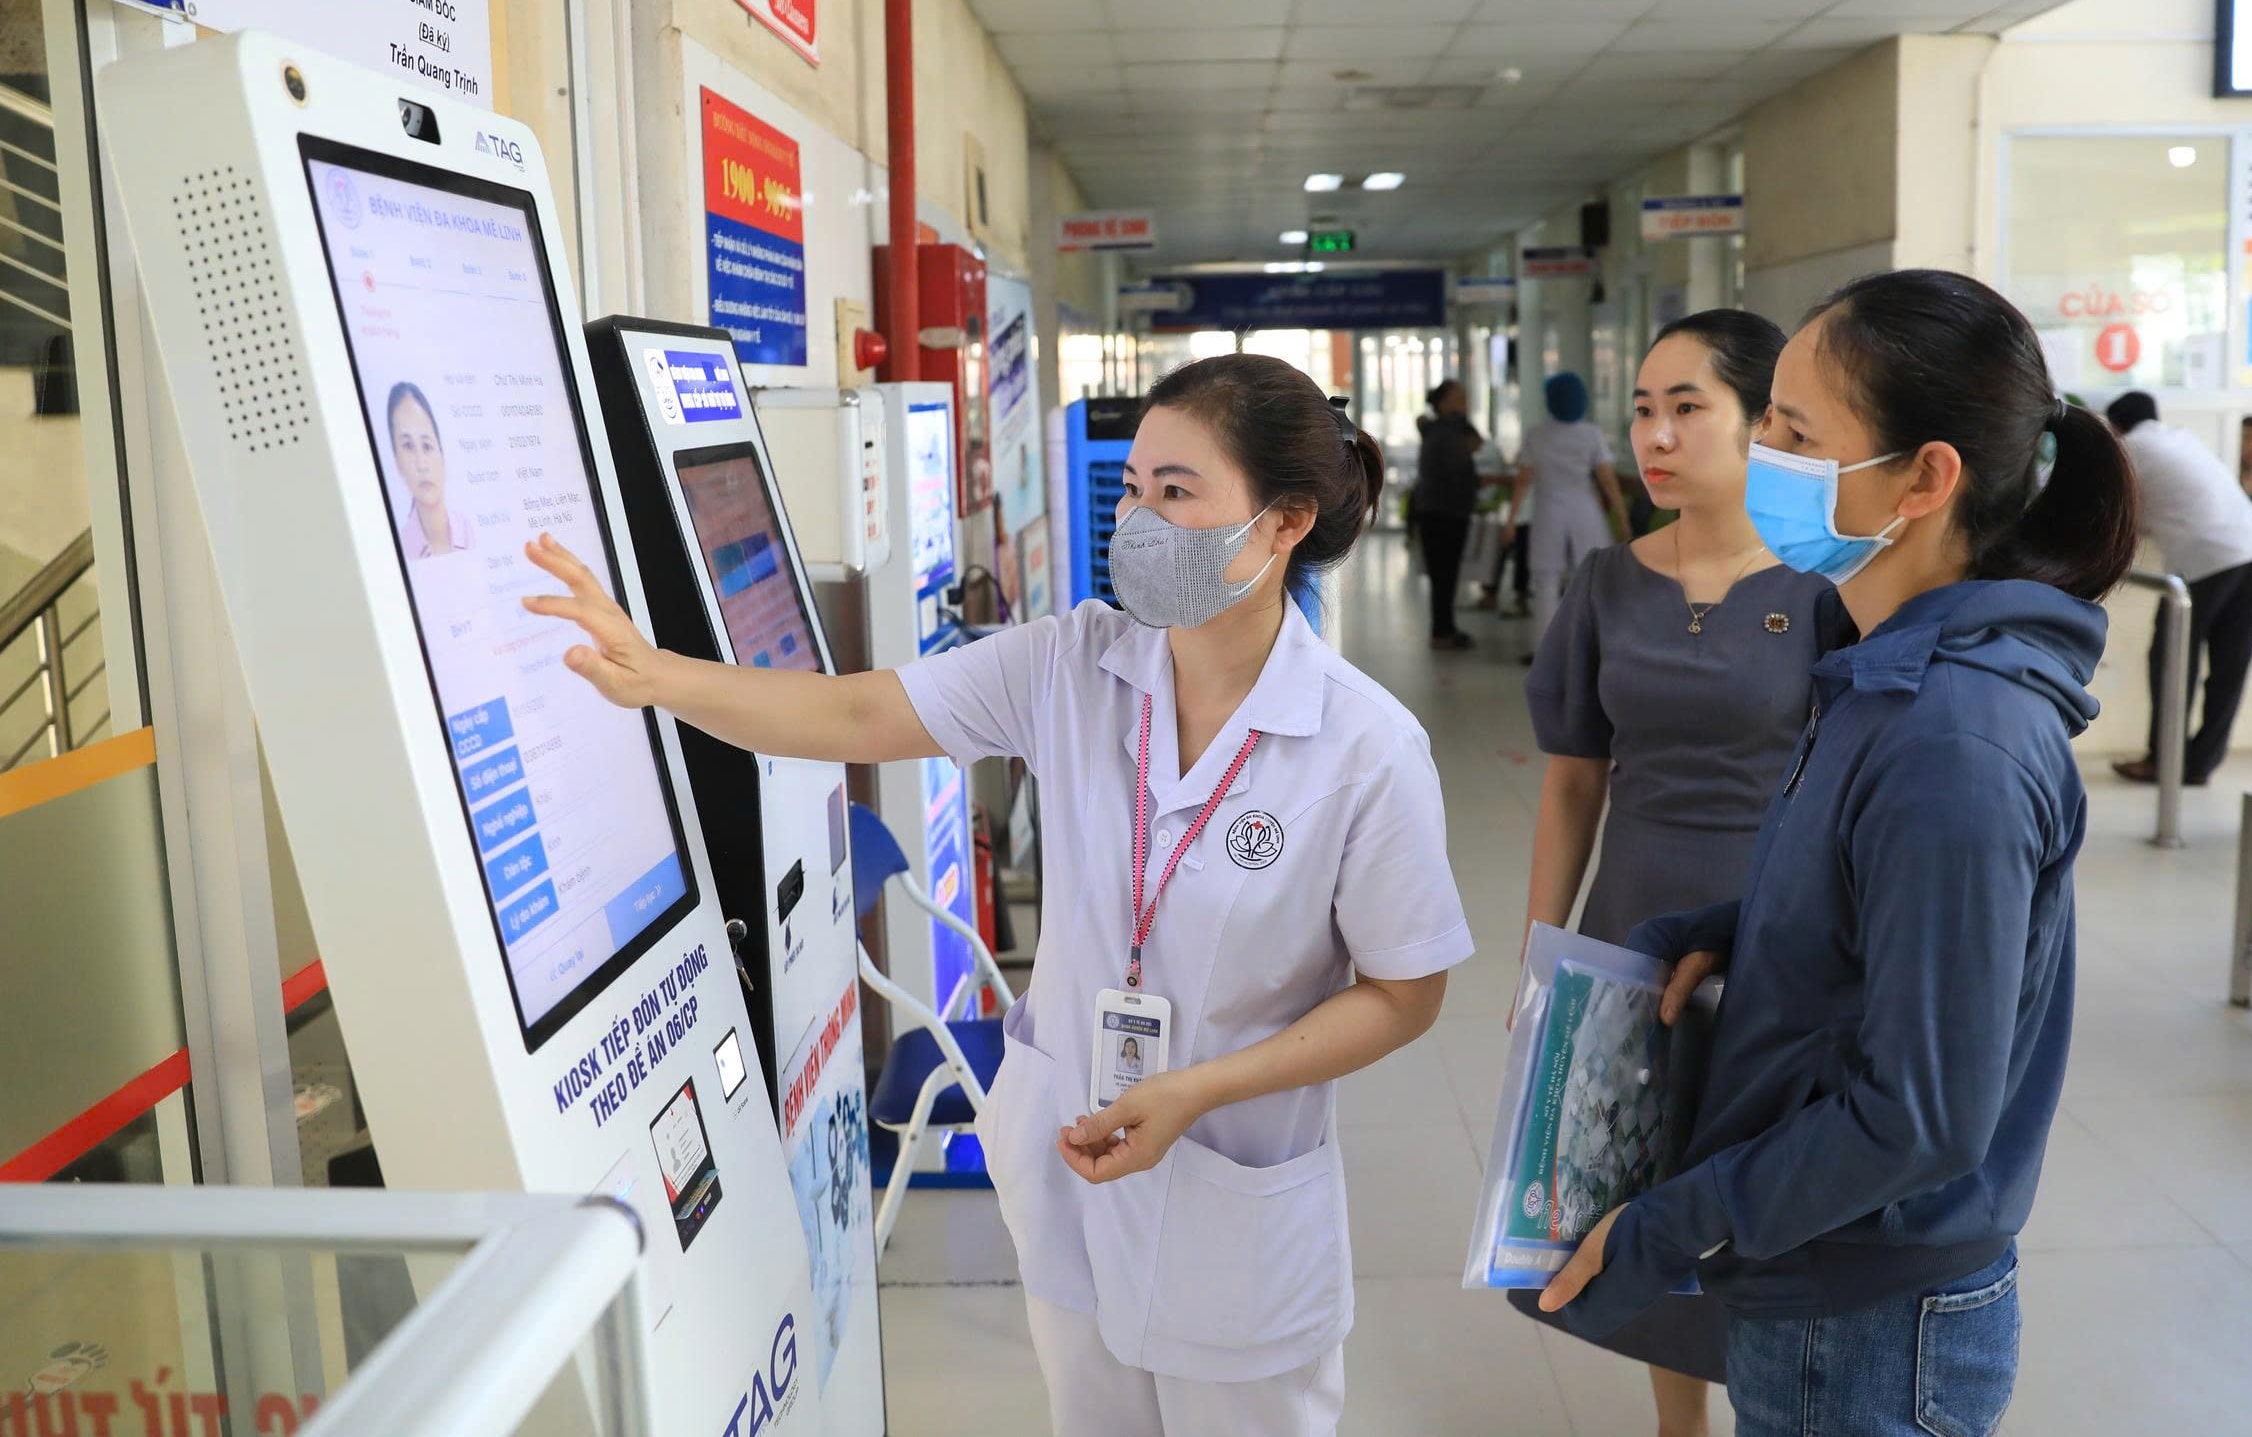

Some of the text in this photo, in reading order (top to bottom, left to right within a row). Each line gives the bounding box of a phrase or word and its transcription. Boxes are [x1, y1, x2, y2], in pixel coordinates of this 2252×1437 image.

[419, 21, 450, 52] (Đã ký)
[390, 42, 478, 95] Trần Quang Trịnh
[488, 134, 524, 164] TAG
[721, 156, 755, 207] 1900
[452, 213, 482, 235] KHOA
[2108, 332, 2129, 363] 1
[553, 943, 709, 1114] KIOSK TIẾP ĐÓN TỰ ĐỘNG
[589, 995, 698, 1128] THEO ĐỀ ÁN 06/CP
[784, 1072, 805, 1139] BỆNH
[804, 1043, 820, 1099] VIỆN
